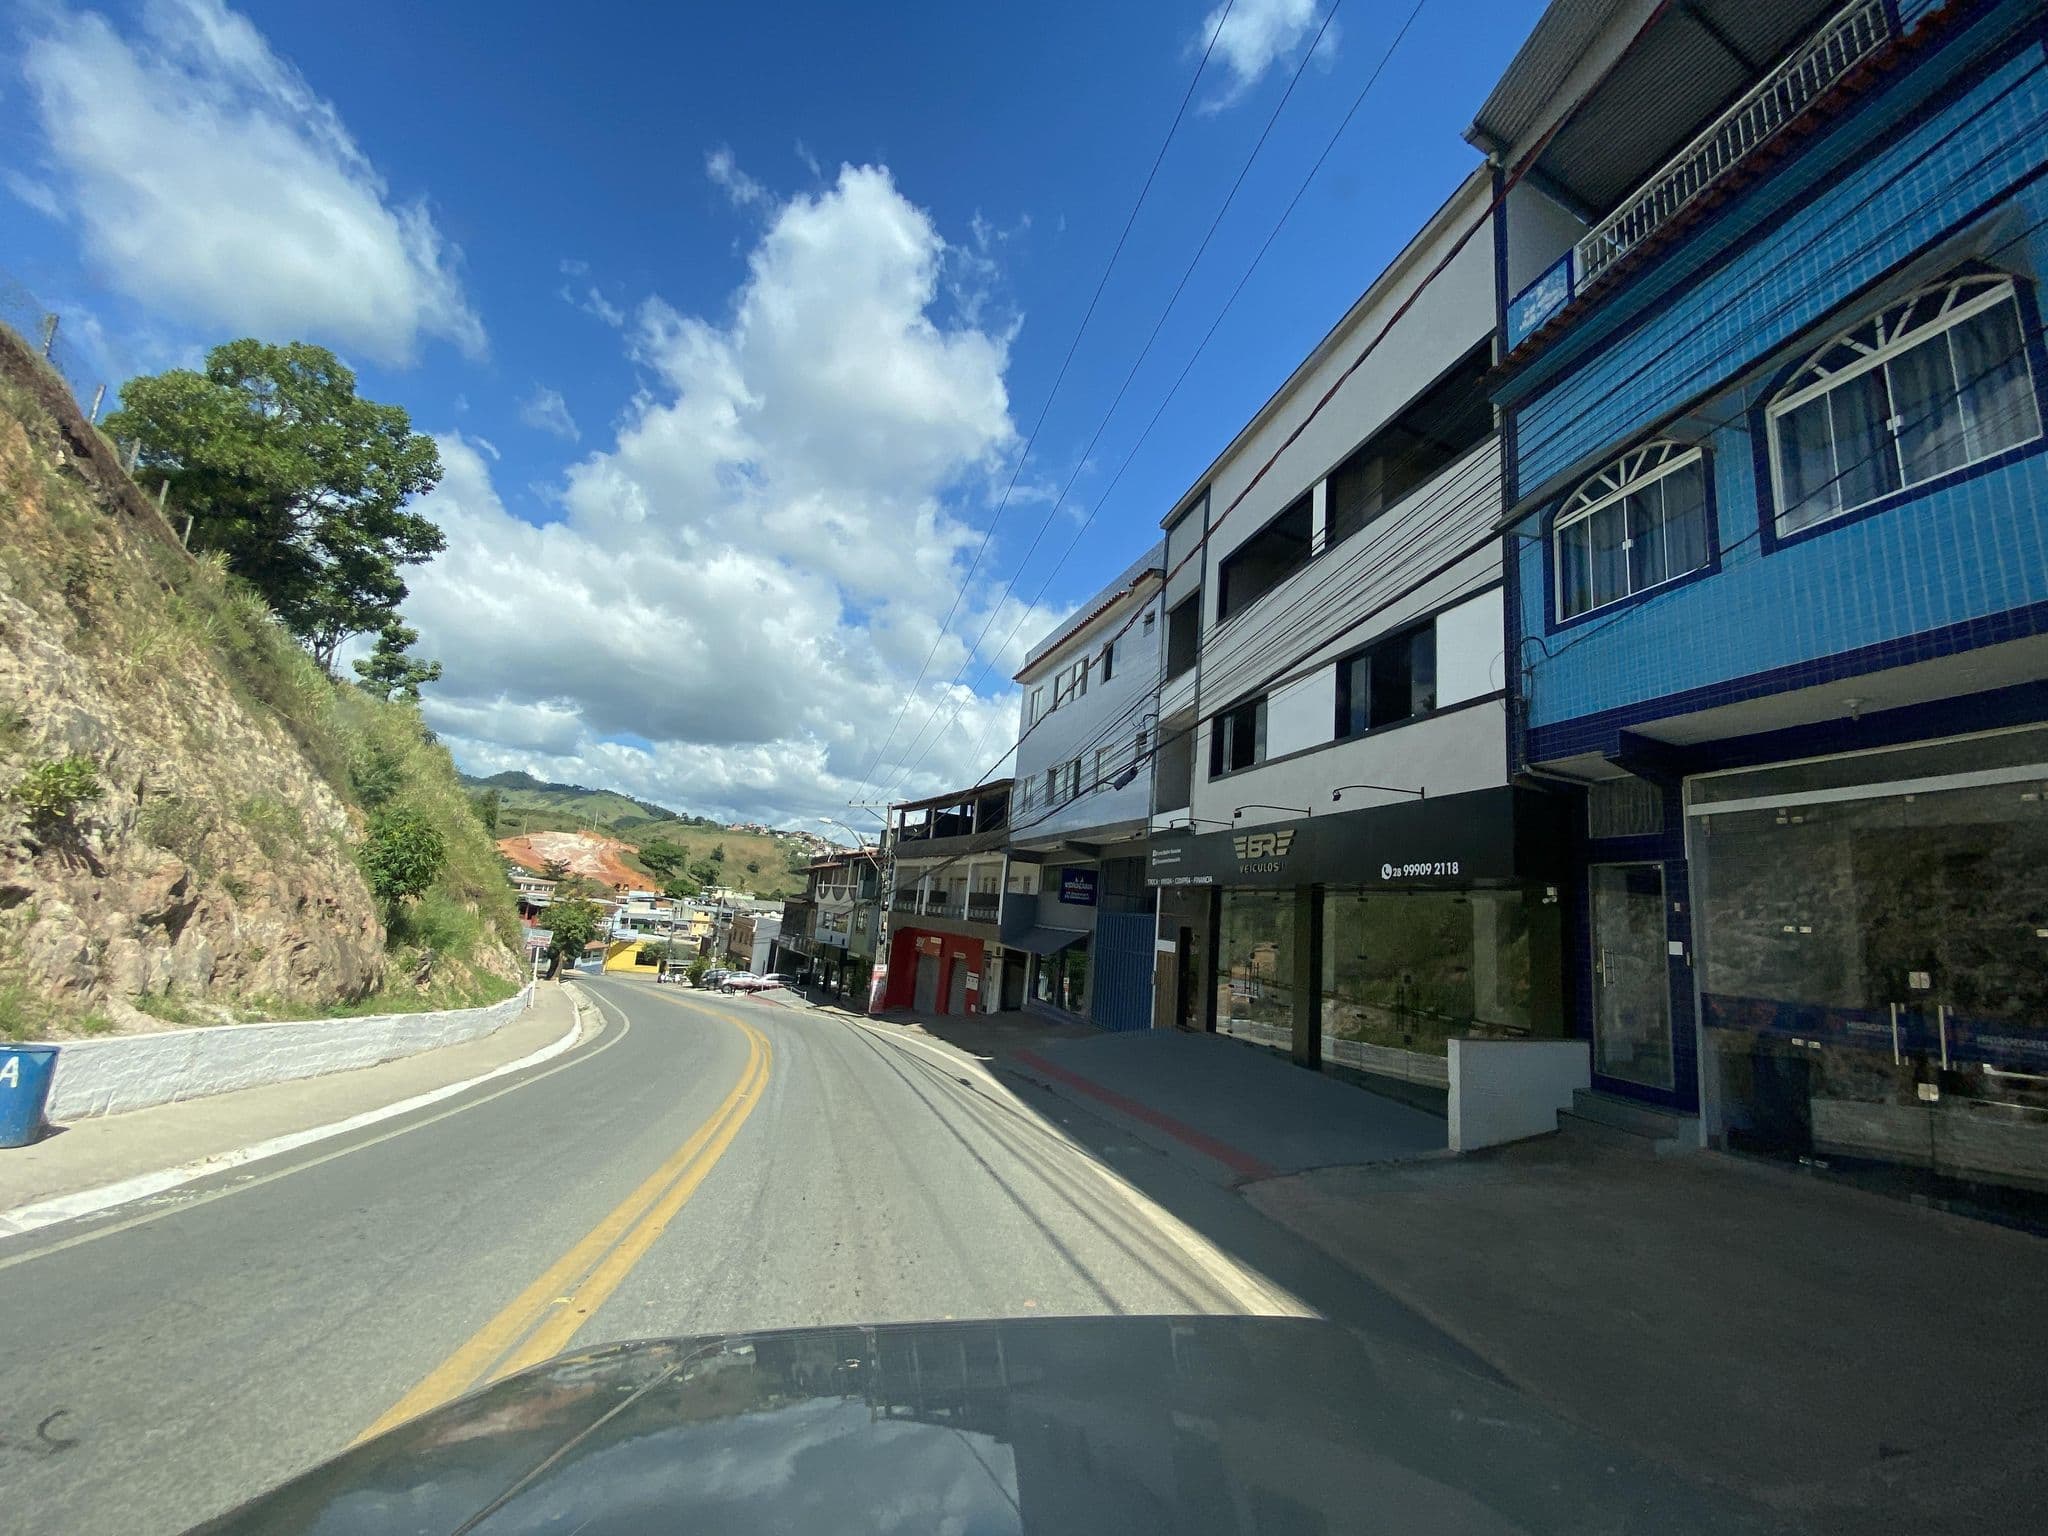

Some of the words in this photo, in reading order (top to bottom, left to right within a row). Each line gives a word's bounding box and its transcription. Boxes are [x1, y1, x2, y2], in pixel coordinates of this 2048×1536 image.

[1392, 867, 1402, 877] 28
[1403, 864, 1431, 876] 99909
[1434, 862, 1459, 875] 2118
